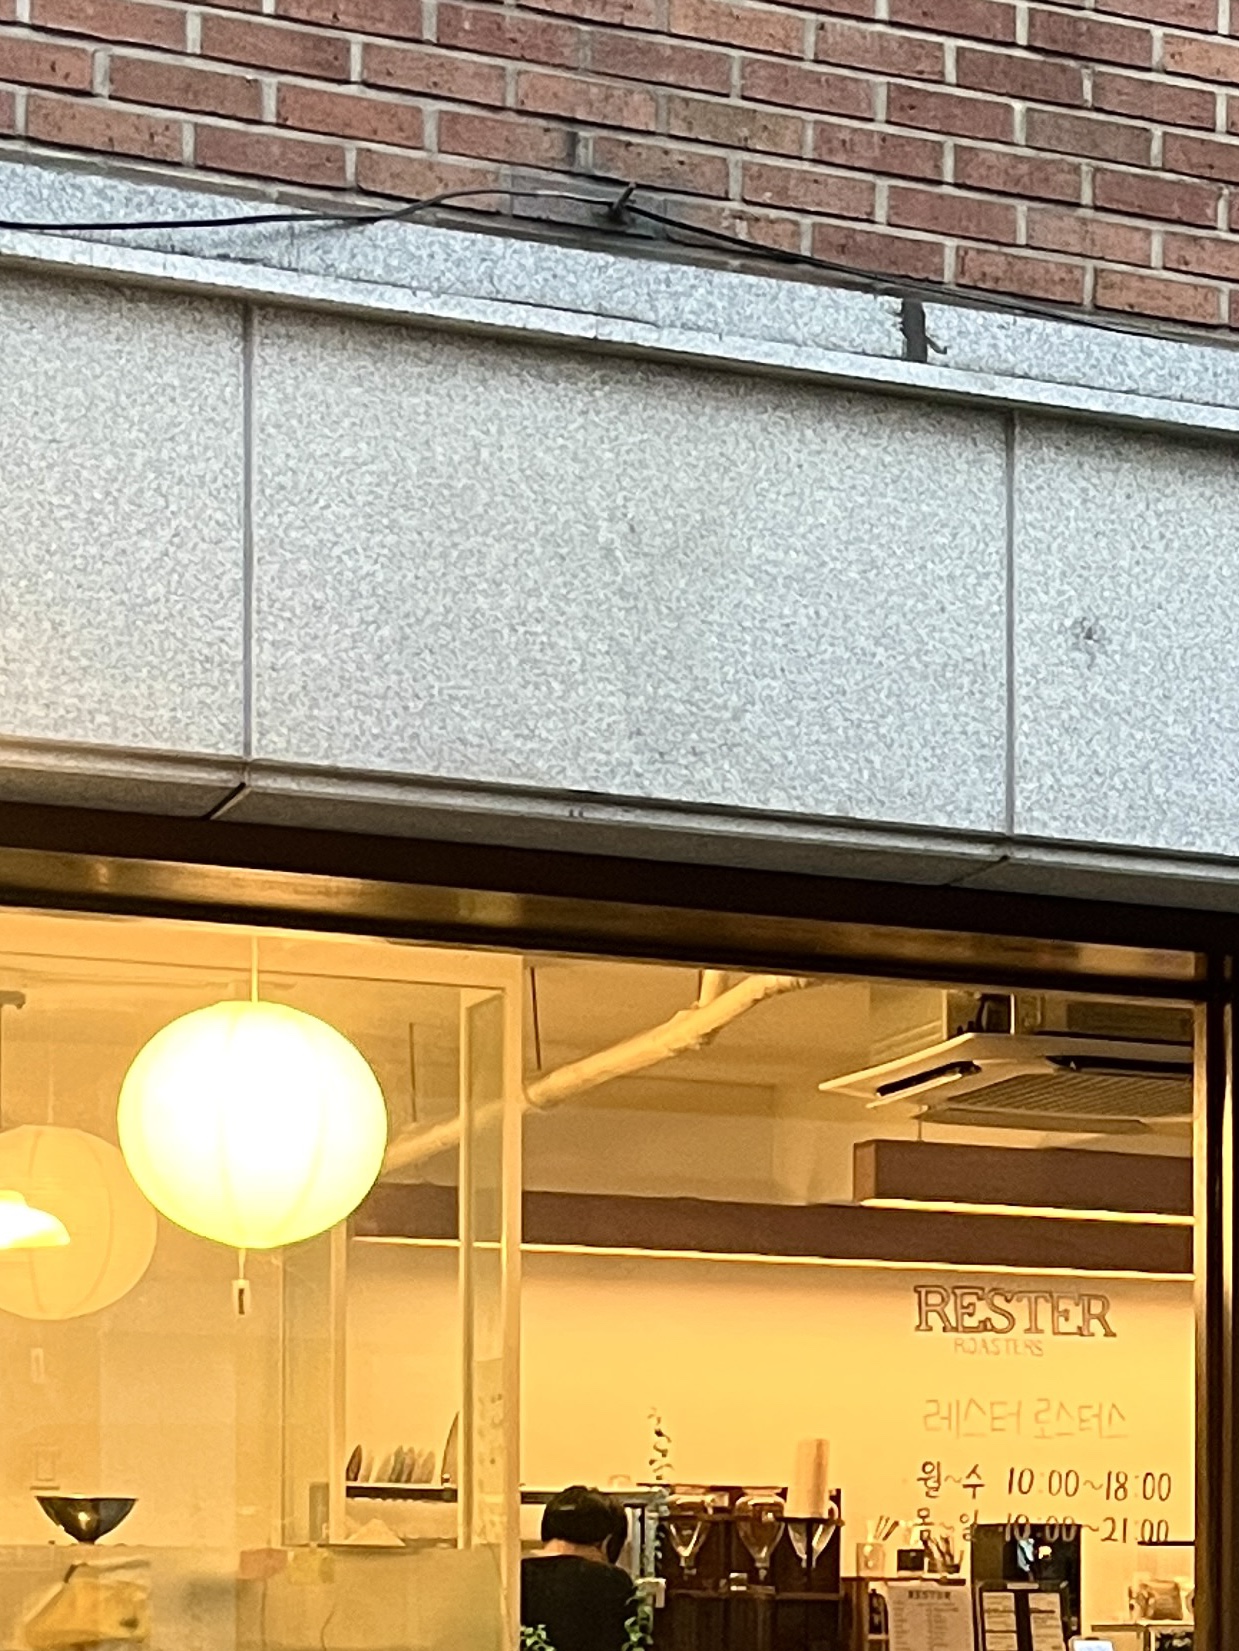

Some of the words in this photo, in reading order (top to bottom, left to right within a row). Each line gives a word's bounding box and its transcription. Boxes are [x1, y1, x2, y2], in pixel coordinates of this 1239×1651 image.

[914, 1284, 1117, 1338] RESTER
[921, 1398, 1023, 1439] 레스터
[1033, 1397, 1129, 1440] 로스터스
